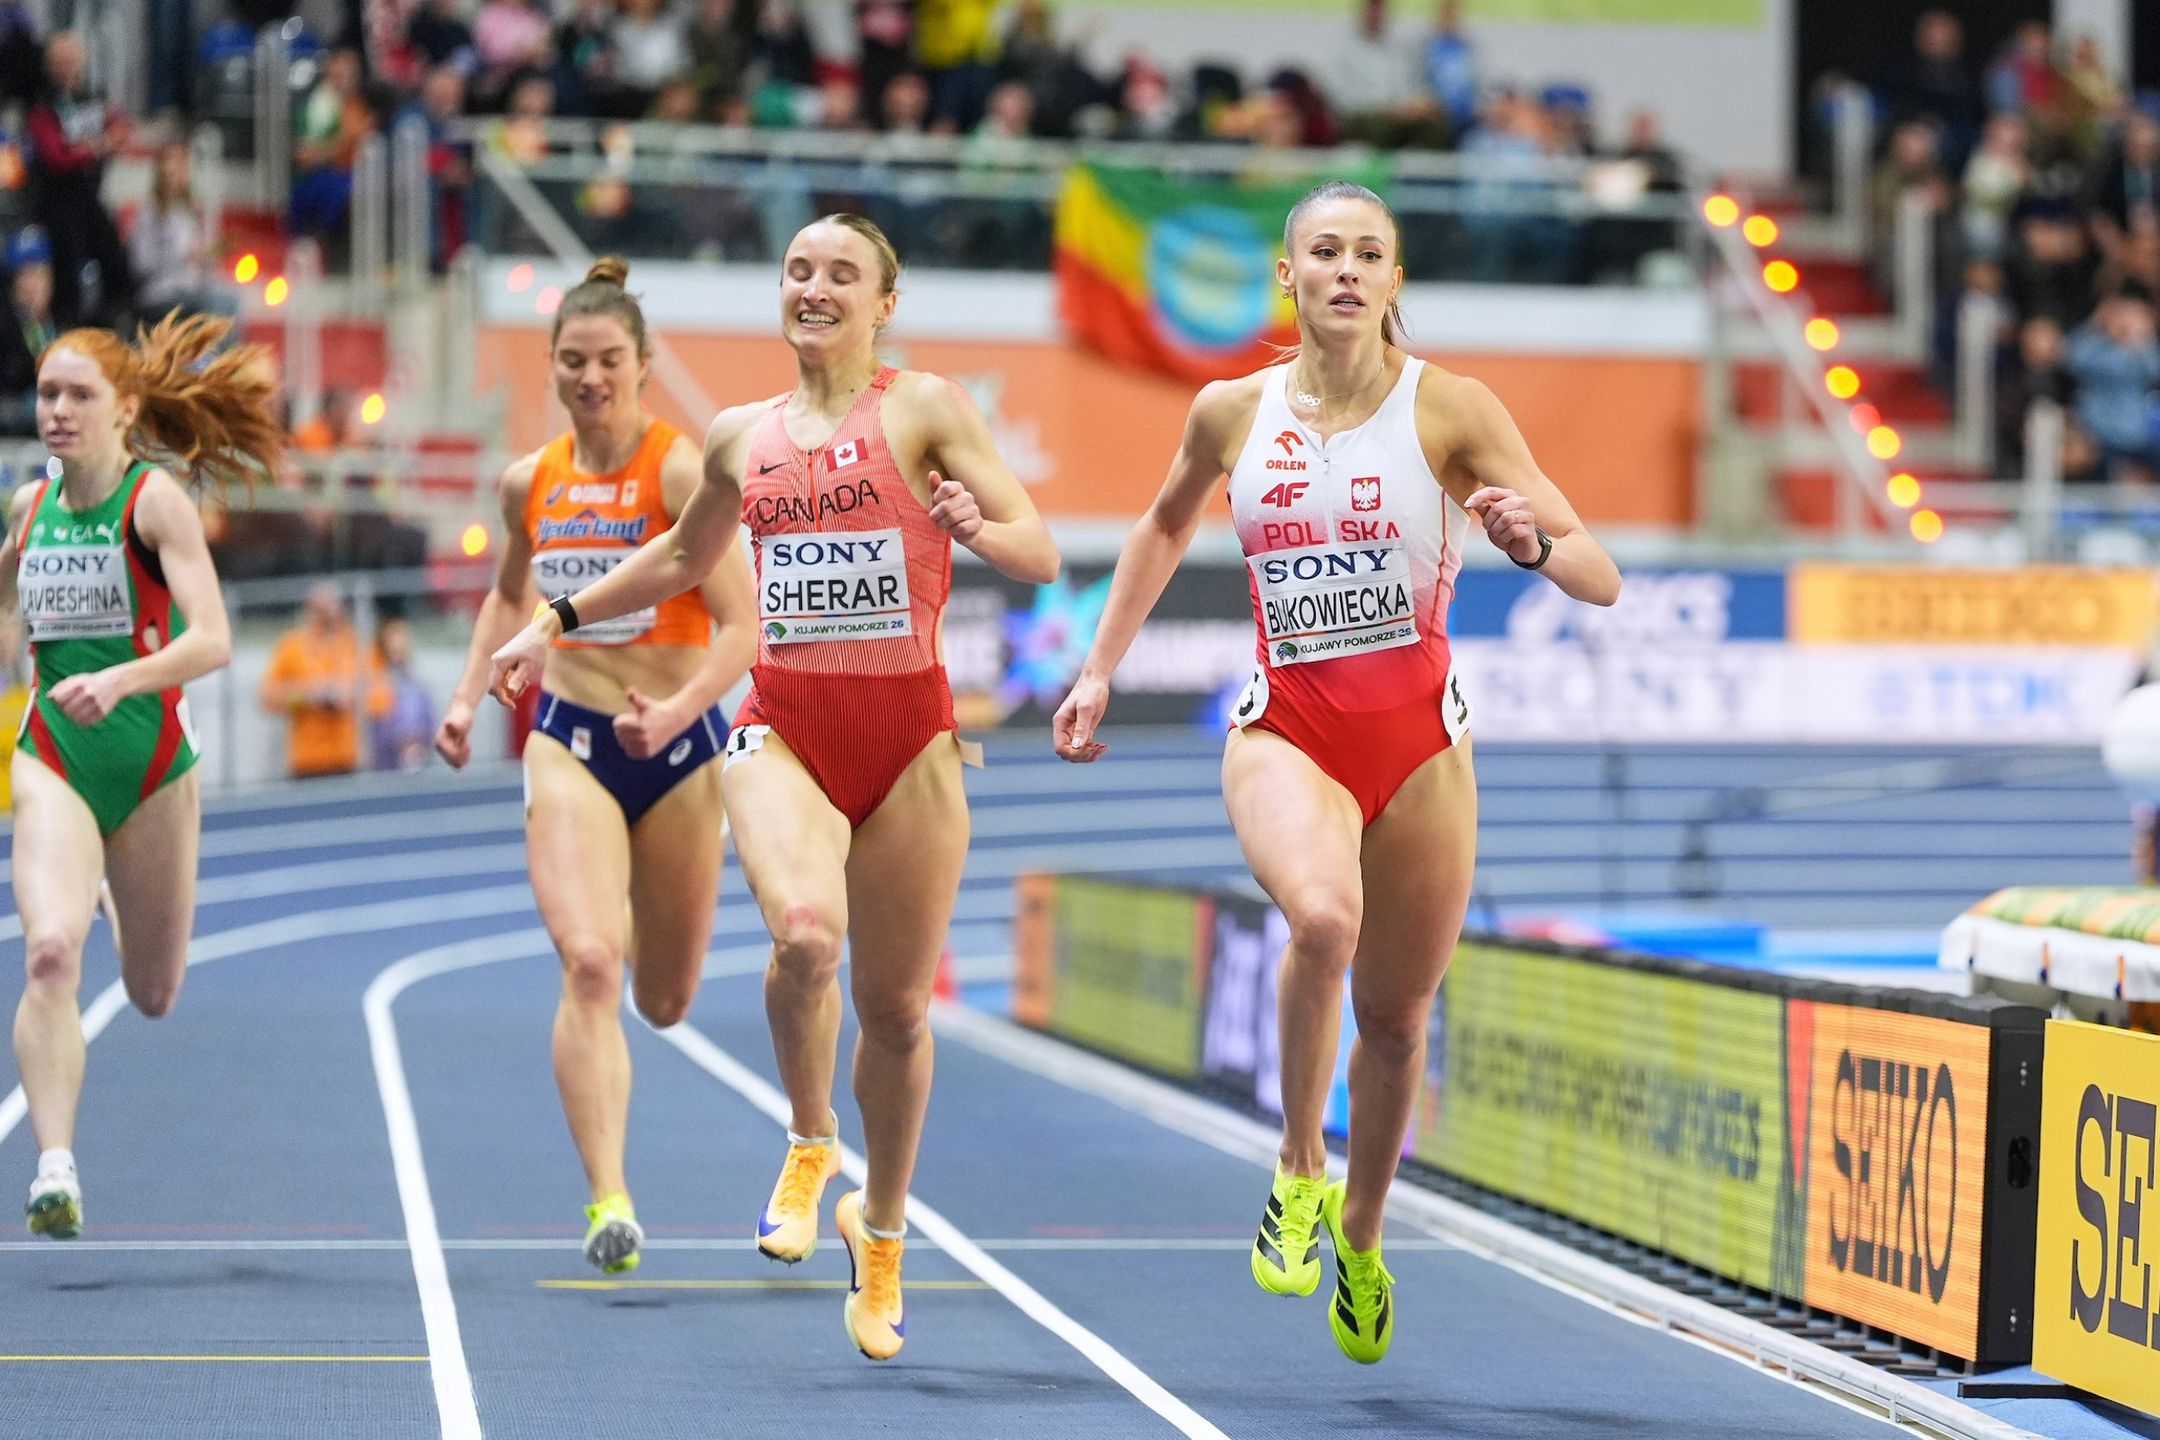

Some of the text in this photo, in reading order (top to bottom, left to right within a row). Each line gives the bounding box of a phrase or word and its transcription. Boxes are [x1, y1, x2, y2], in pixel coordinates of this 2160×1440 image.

[1266, 459, 1306, 470] ORLEN
[756, 479, 880, 525] CANADA
[1261, 481, 1310, 508] 4F
[25, 553, 110, 577] SONY
[541, 556, 625, 578] SON
[773, 539, 888, 567] SONY
[1263, 549, 1391, 584] SONY
[766, 575, 899, 613] SHERAR
[1266, 582, 1411, 634] BUKOWIECKA
[794, 620, 904, 635] KUJAWY POMORZE 26
[1299, 640, 1342, 654] KUJAWY
[1344, 629, 1397, 648] POMORZE
[1829, 1049, 1957, 1304] SEIKO
[2069, 1083, 2160, 1352] SE
